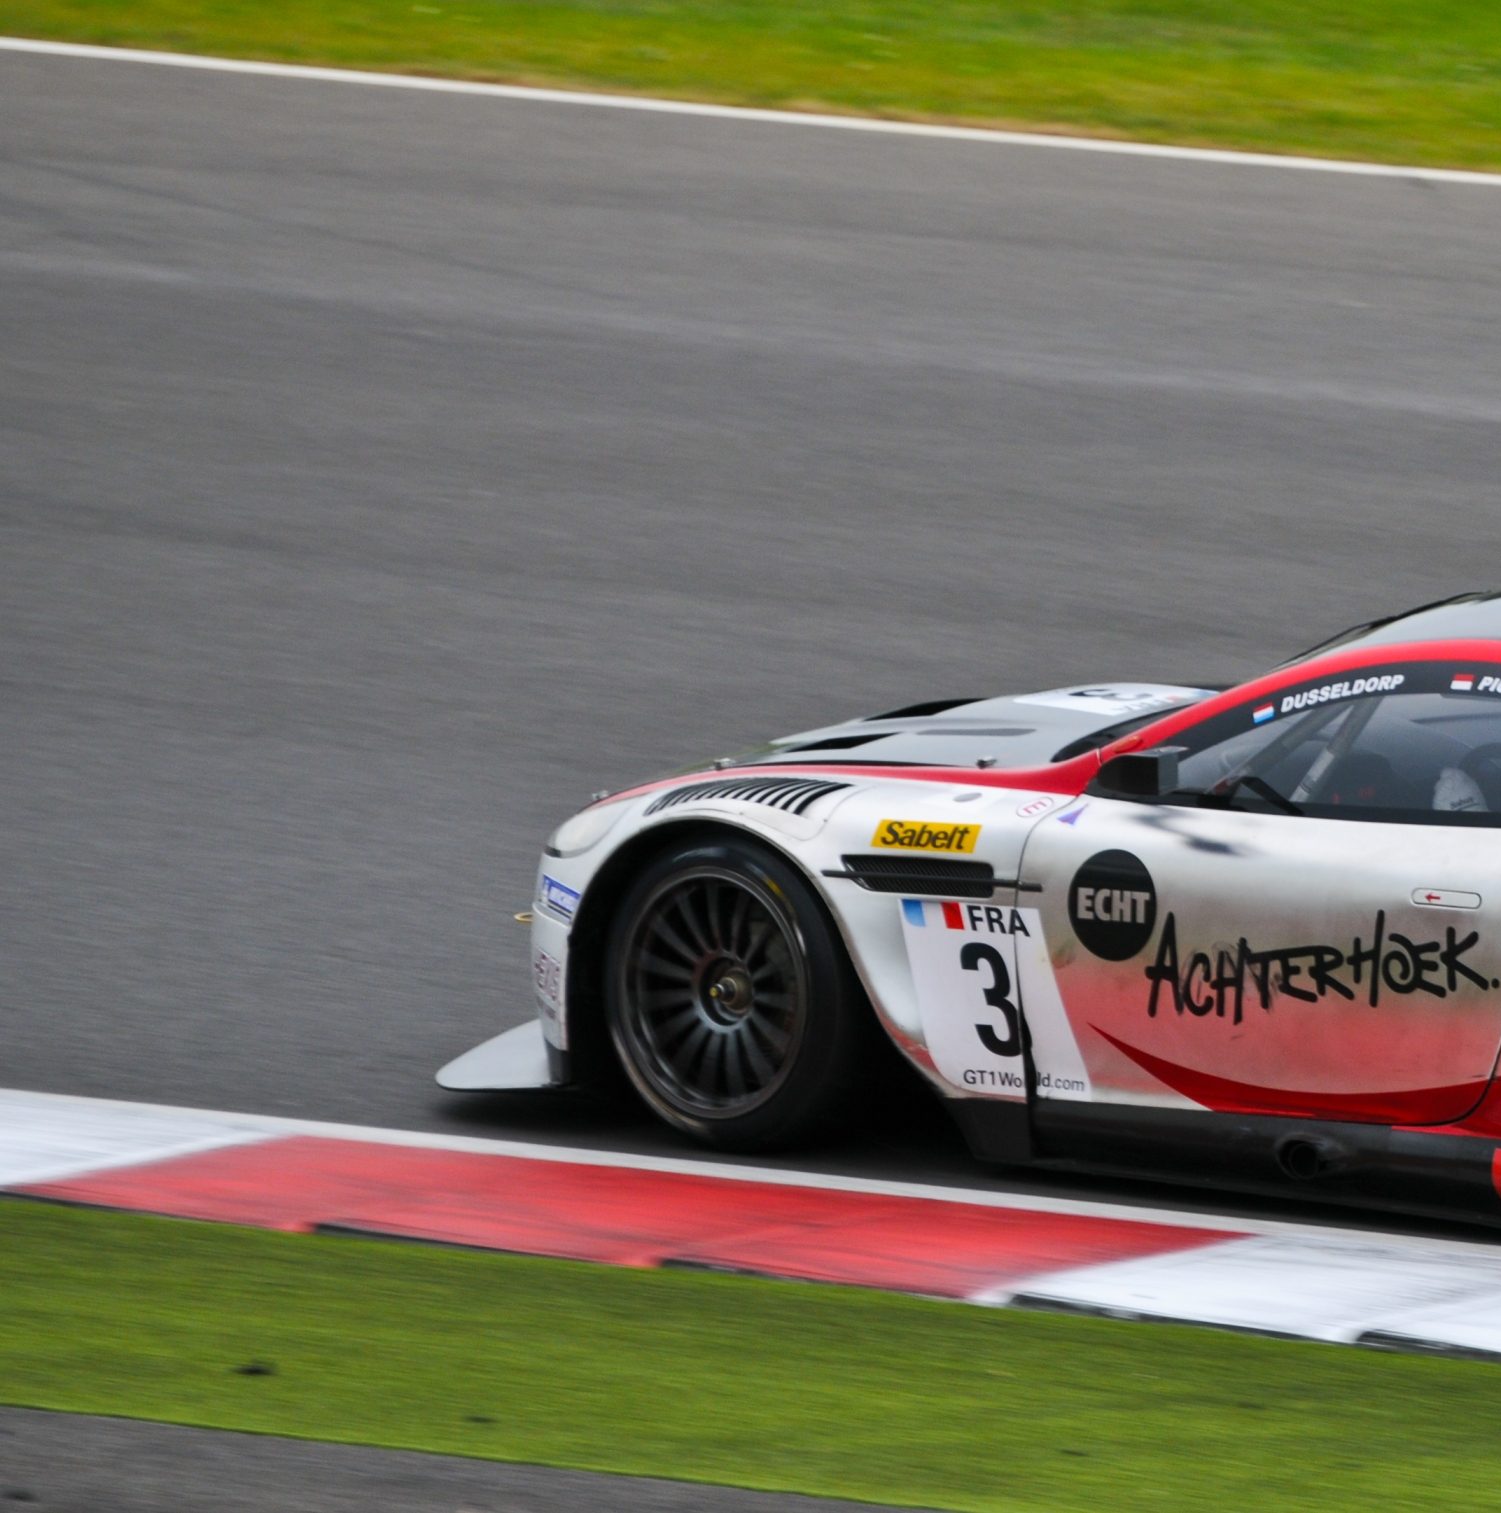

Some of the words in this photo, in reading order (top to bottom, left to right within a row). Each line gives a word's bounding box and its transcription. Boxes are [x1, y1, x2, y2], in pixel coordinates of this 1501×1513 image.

[1281, 674, 1405, 713] DUSSELDORP
[881, 821, 970, 850] Sabelt
[966, 904, 1031, 937] FRA
[1077, 887, 1151, 925] ECHT
[960, 942, 1024, 1058] 3
[963, 1068, 1085, 1092] GT1Wold.com
